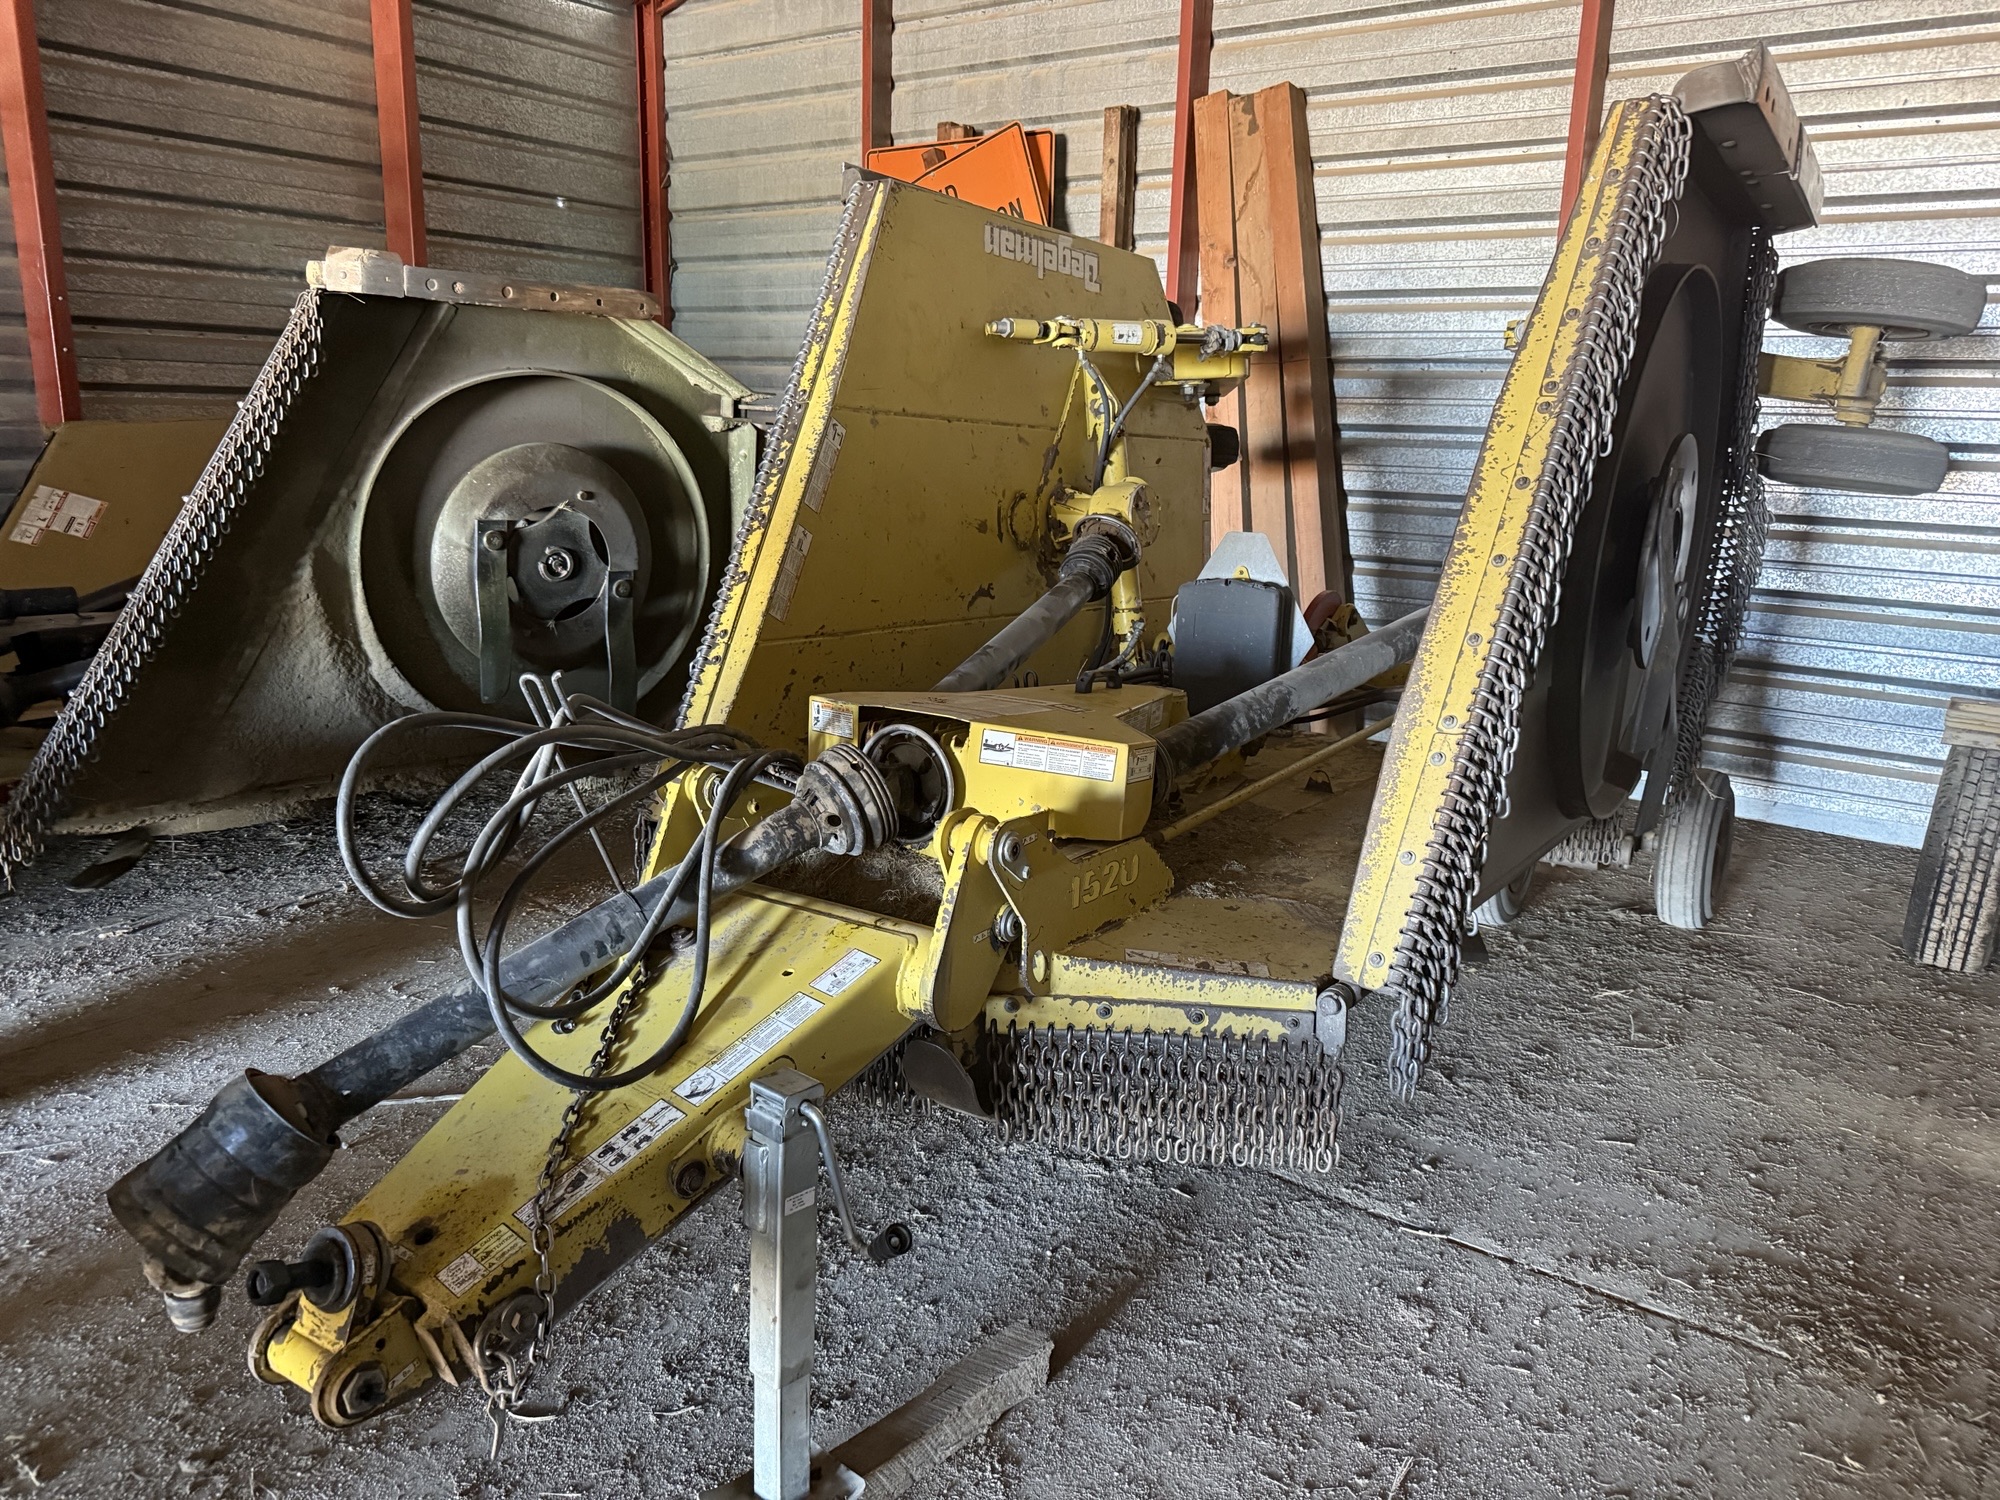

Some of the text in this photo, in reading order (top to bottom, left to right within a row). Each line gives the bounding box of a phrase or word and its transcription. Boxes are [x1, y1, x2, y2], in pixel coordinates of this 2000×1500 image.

[984, 223, 1101, 293] Degelman
[1024, 736, 1048, 745] WARNING
[716, 1043, 738, 1060] CAUTION
[480, 1229, 502, 1247] CAUTION
